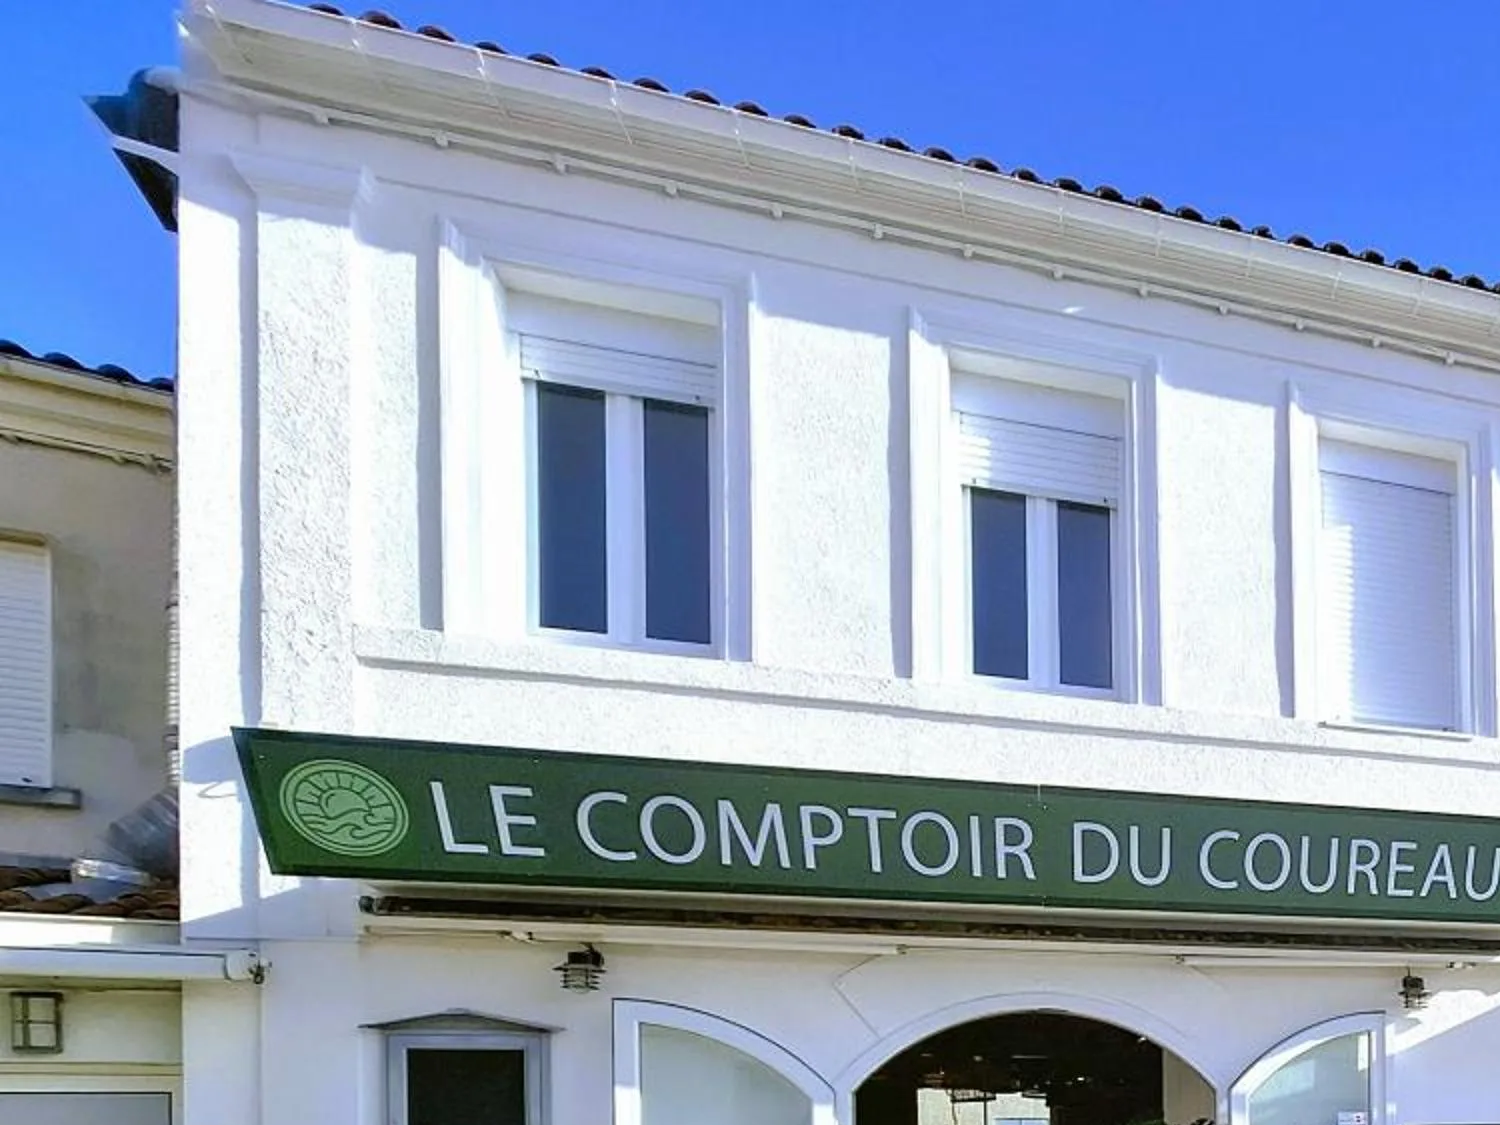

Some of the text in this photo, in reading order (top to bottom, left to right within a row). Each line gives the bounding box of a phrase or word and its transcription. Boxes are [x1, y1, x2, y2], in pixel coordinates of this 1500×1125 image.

[430, 781, 545, 857] LE
[576, 792, 1036, 878] COMPTOIR
[1073, 822, 1171, 886] DU
